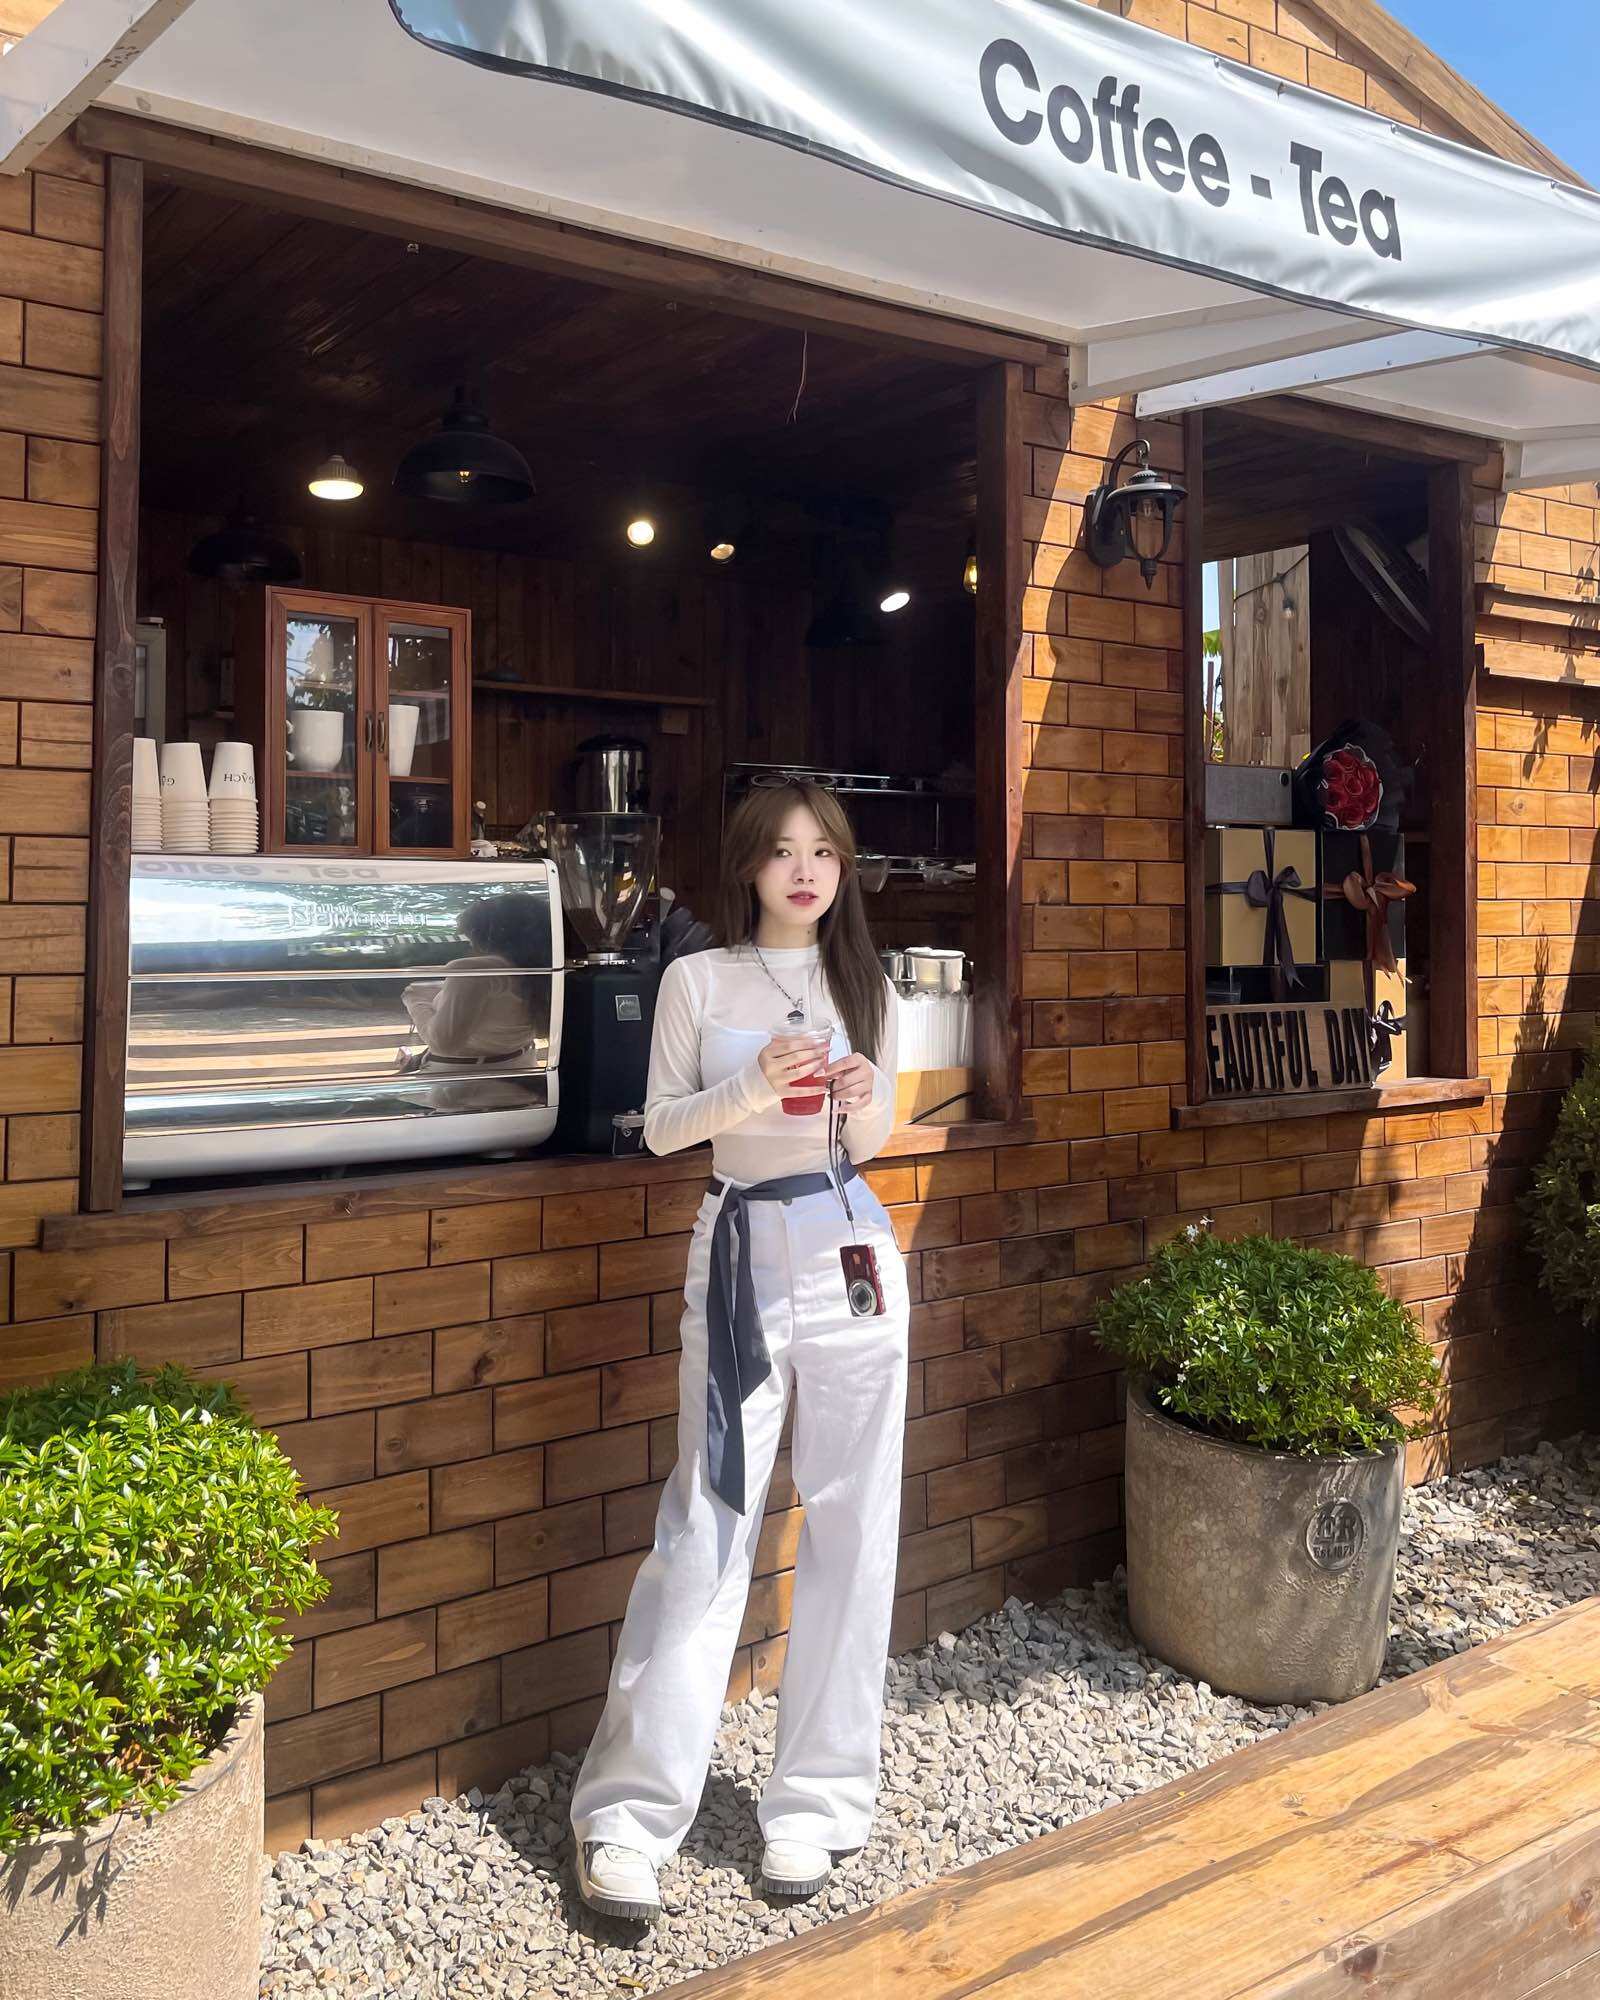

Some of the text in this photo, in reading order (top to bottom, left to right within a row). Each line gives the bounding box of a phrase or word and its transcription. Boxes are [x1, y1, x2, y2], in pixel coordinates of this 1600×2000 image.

[979, 38, 1402, 261] Coffee - Tea
[1324, 1008, 1371, 1085] DAY
